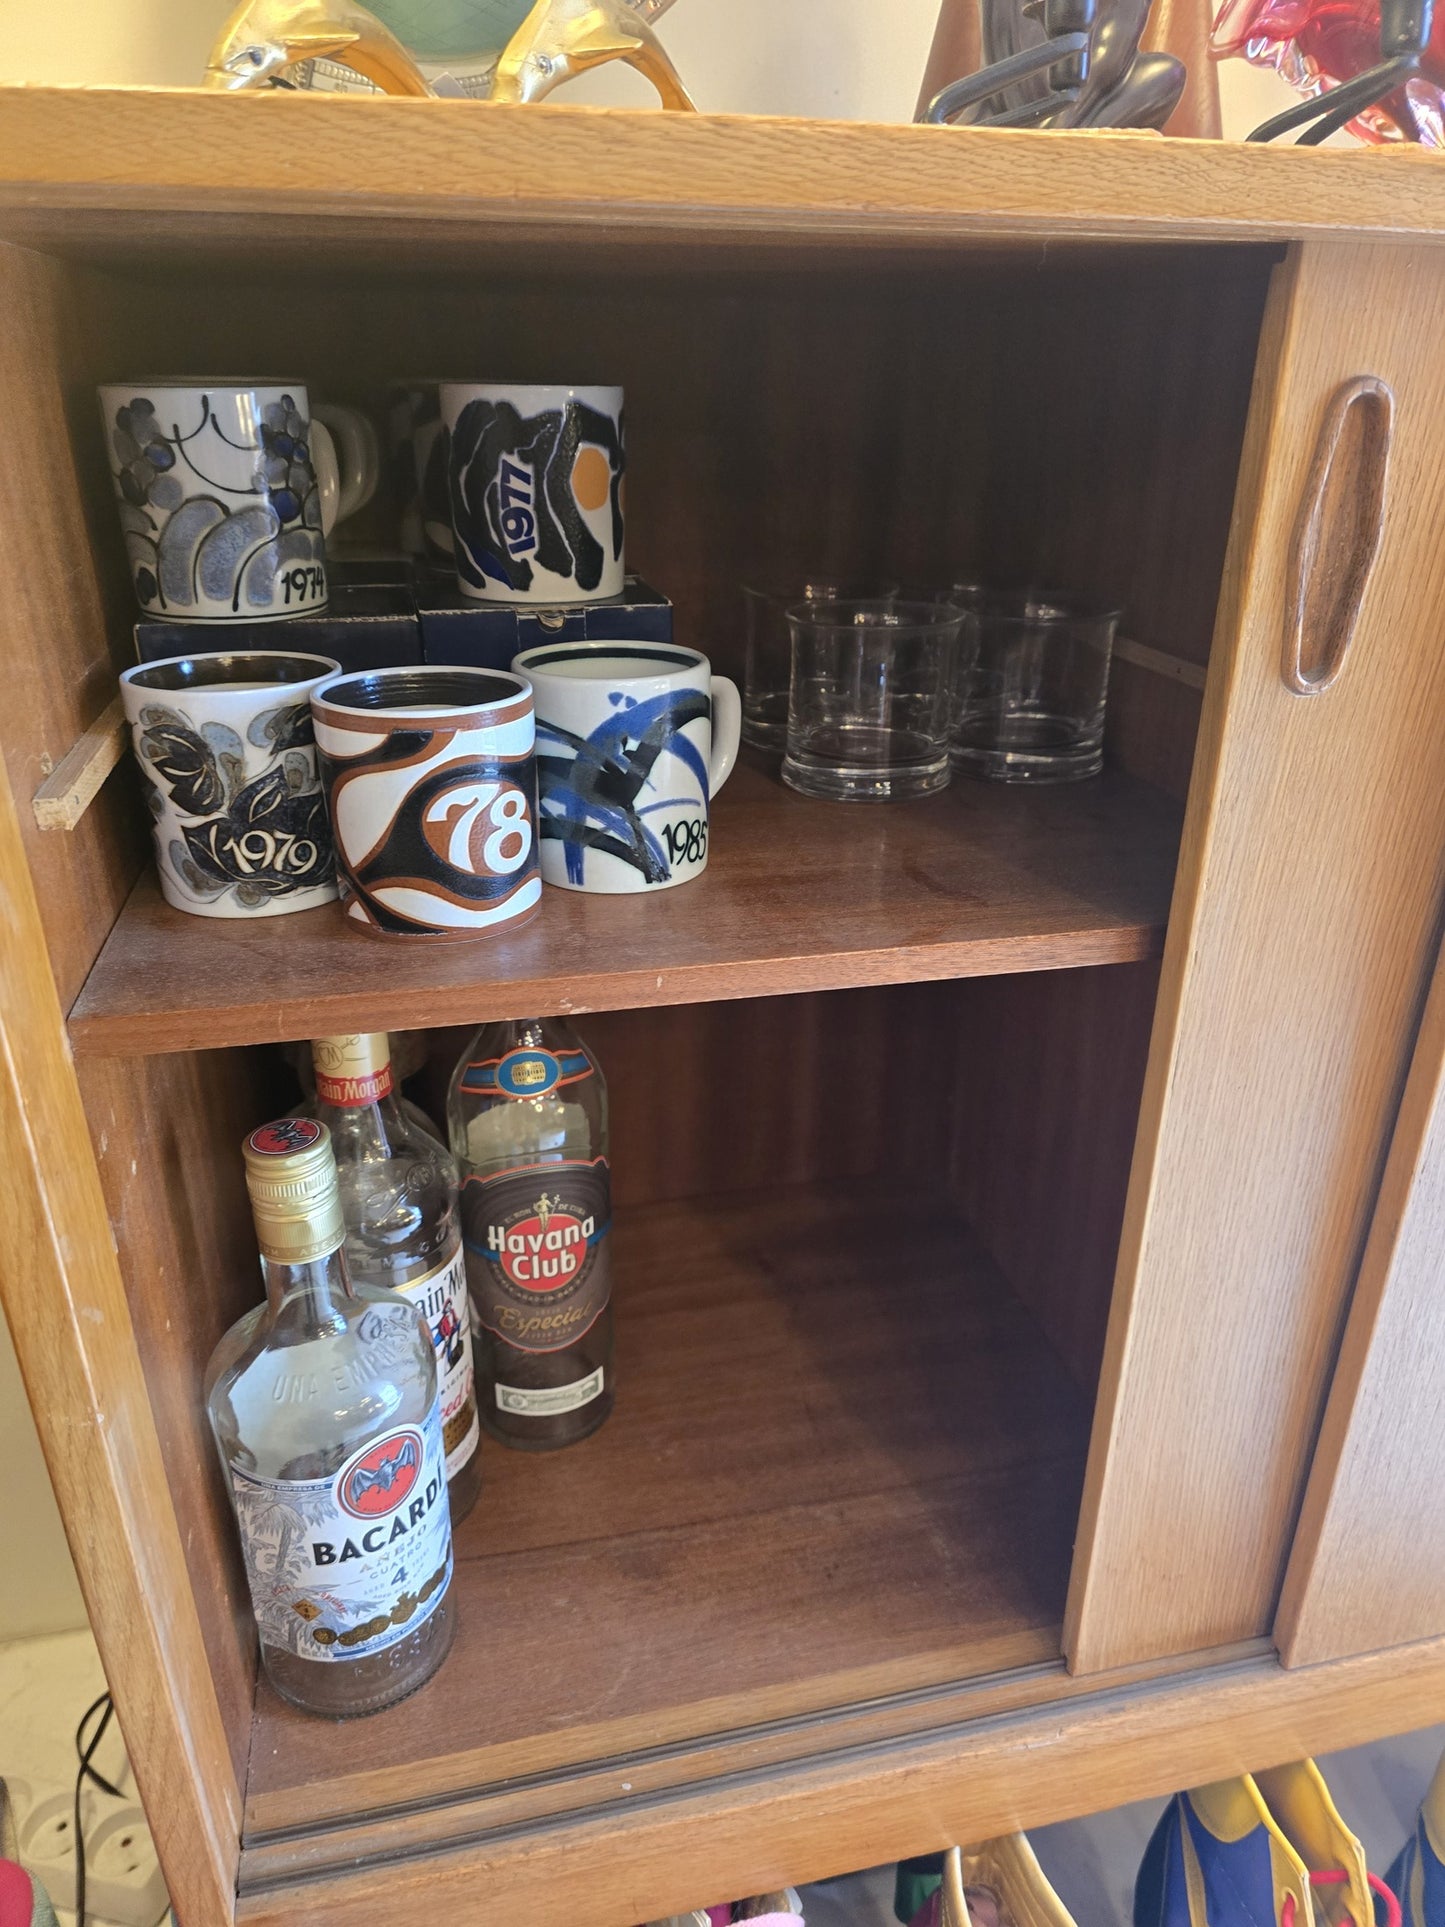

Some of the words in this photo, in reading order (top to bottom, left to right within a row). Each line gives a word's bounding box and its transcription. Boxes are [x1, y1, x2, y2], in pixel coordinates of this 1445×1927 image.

[500, 459, 536, 555] 1977
[281, 566, 324, 604] 1974
[427, 783, 532, 874] 78
[661, 819, 708, 866] 1985
[222, 829, 318, 875] 1979
[340, 1067, 391, 1102] Morgan
[487, 1215, 595, 1252] Havana
[511, 1249, 576, 1280] Club
[494, 1302, 593, 1338] Especial
[369, 1541, 422, 1580] CUATRO
[390, 1565, 409, 1586] 4
